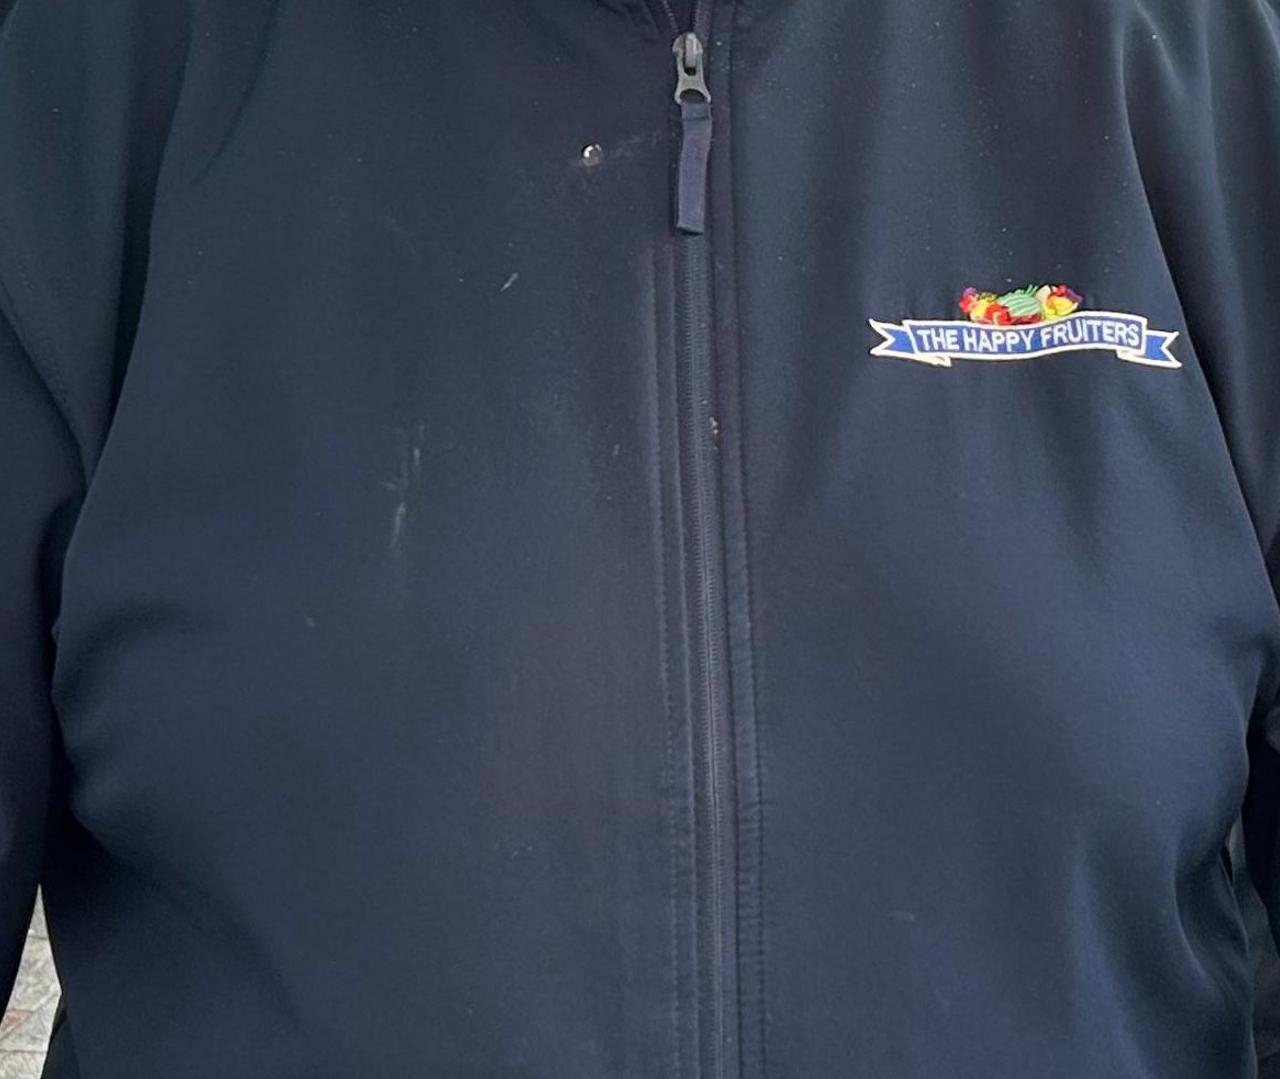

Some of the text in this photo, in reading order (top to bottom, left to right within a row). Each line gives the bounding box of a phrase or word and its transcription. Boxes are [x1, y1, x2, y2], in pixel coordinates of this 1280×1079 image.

[916, 318, 1140, 352] THE HAPPY FRUITERS
